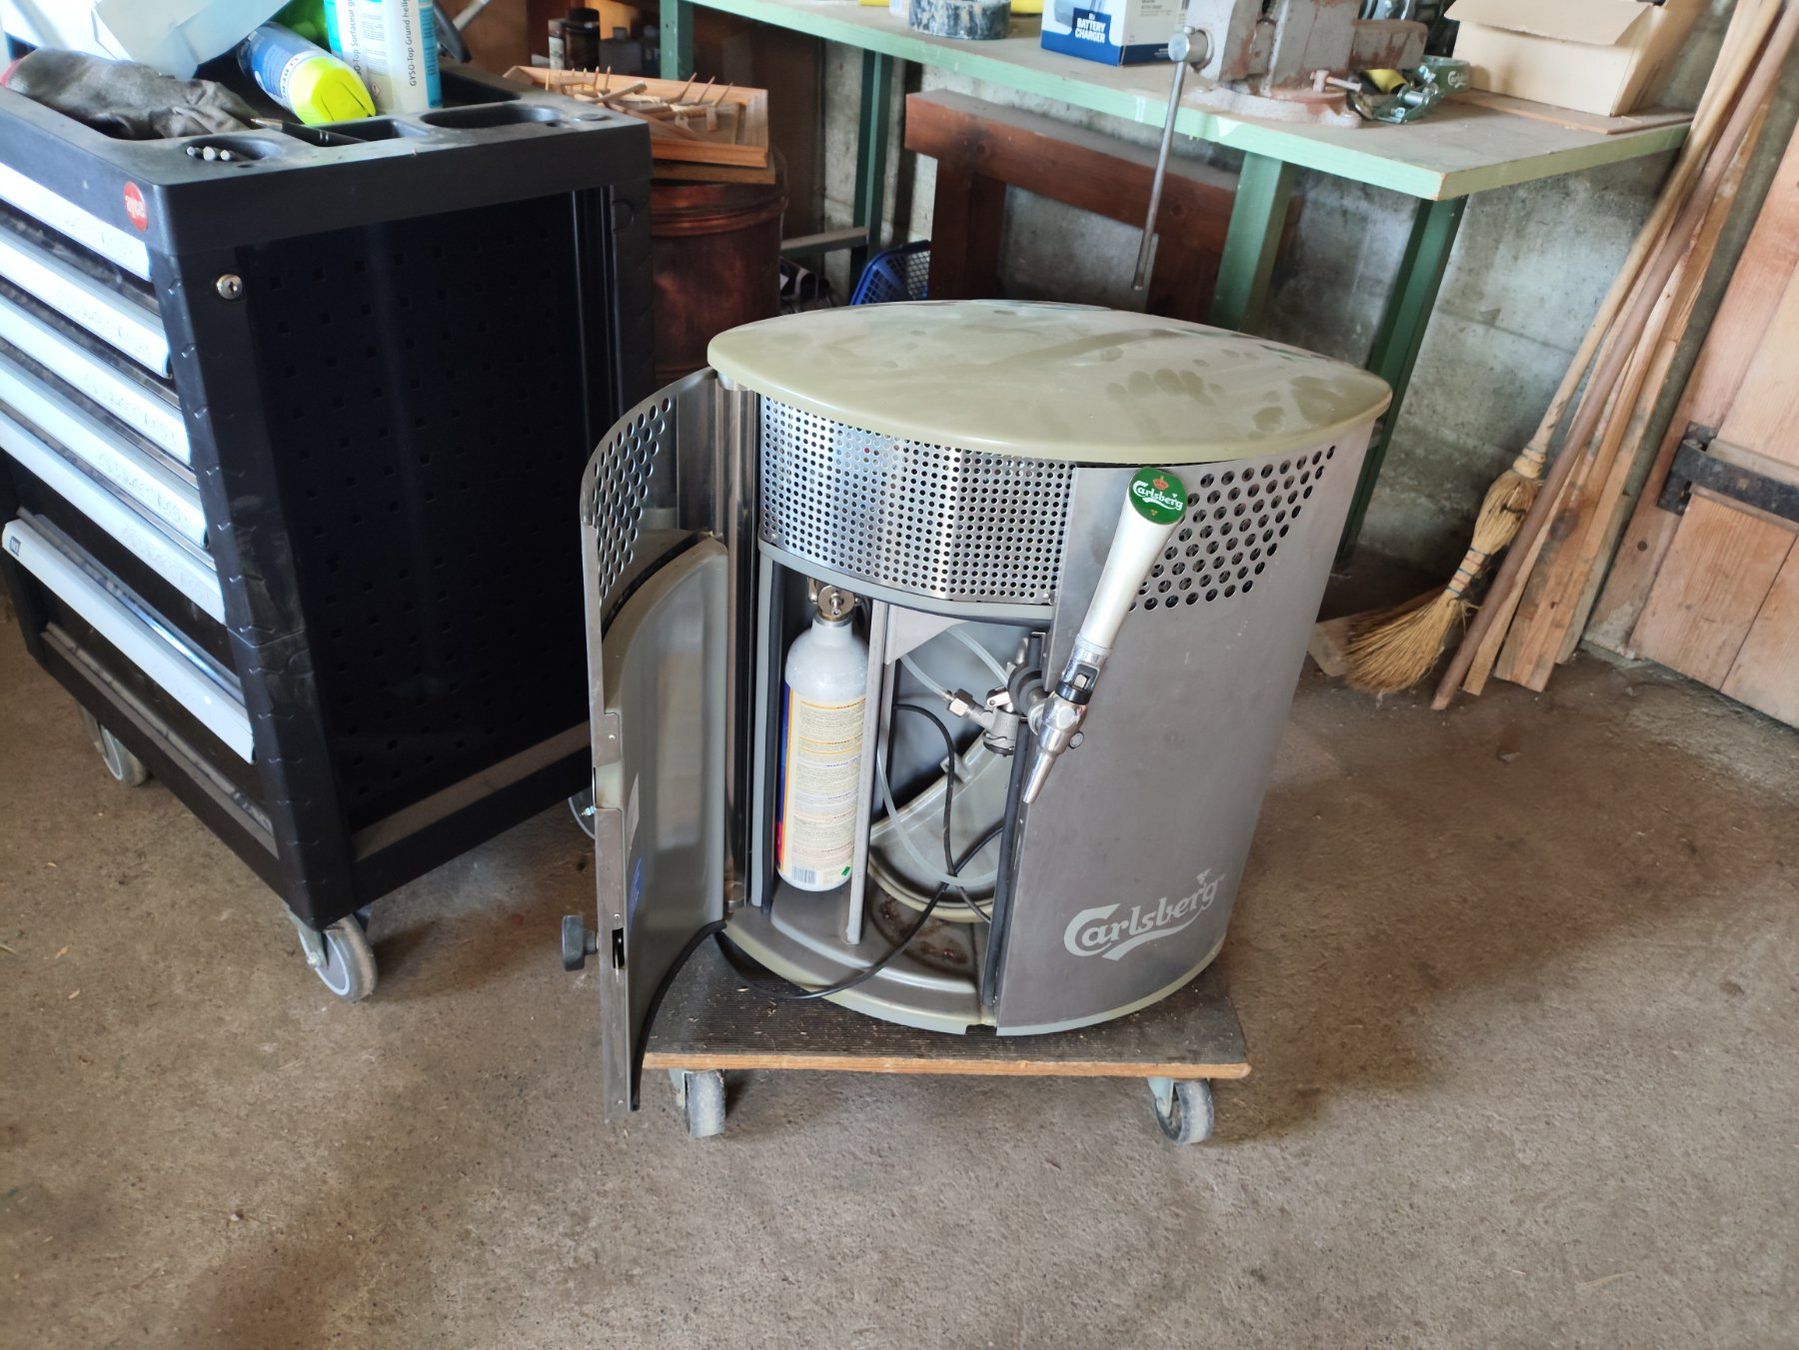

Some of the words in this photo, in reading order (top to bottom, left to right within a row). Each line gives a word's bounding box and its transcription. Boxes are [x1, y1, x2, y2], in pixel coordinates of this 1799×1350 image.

[404, 20, 413, 46] Grund
[1075, 28, 1105, 43] CHARGER
[1077, 18, 1106, 33] BATTERY
[408, 47, 417, 87] GYSO-Top
[1132, 480, 1184, 512] Carlsberg
[1063, 869, 1226, 961] Carlsberg
